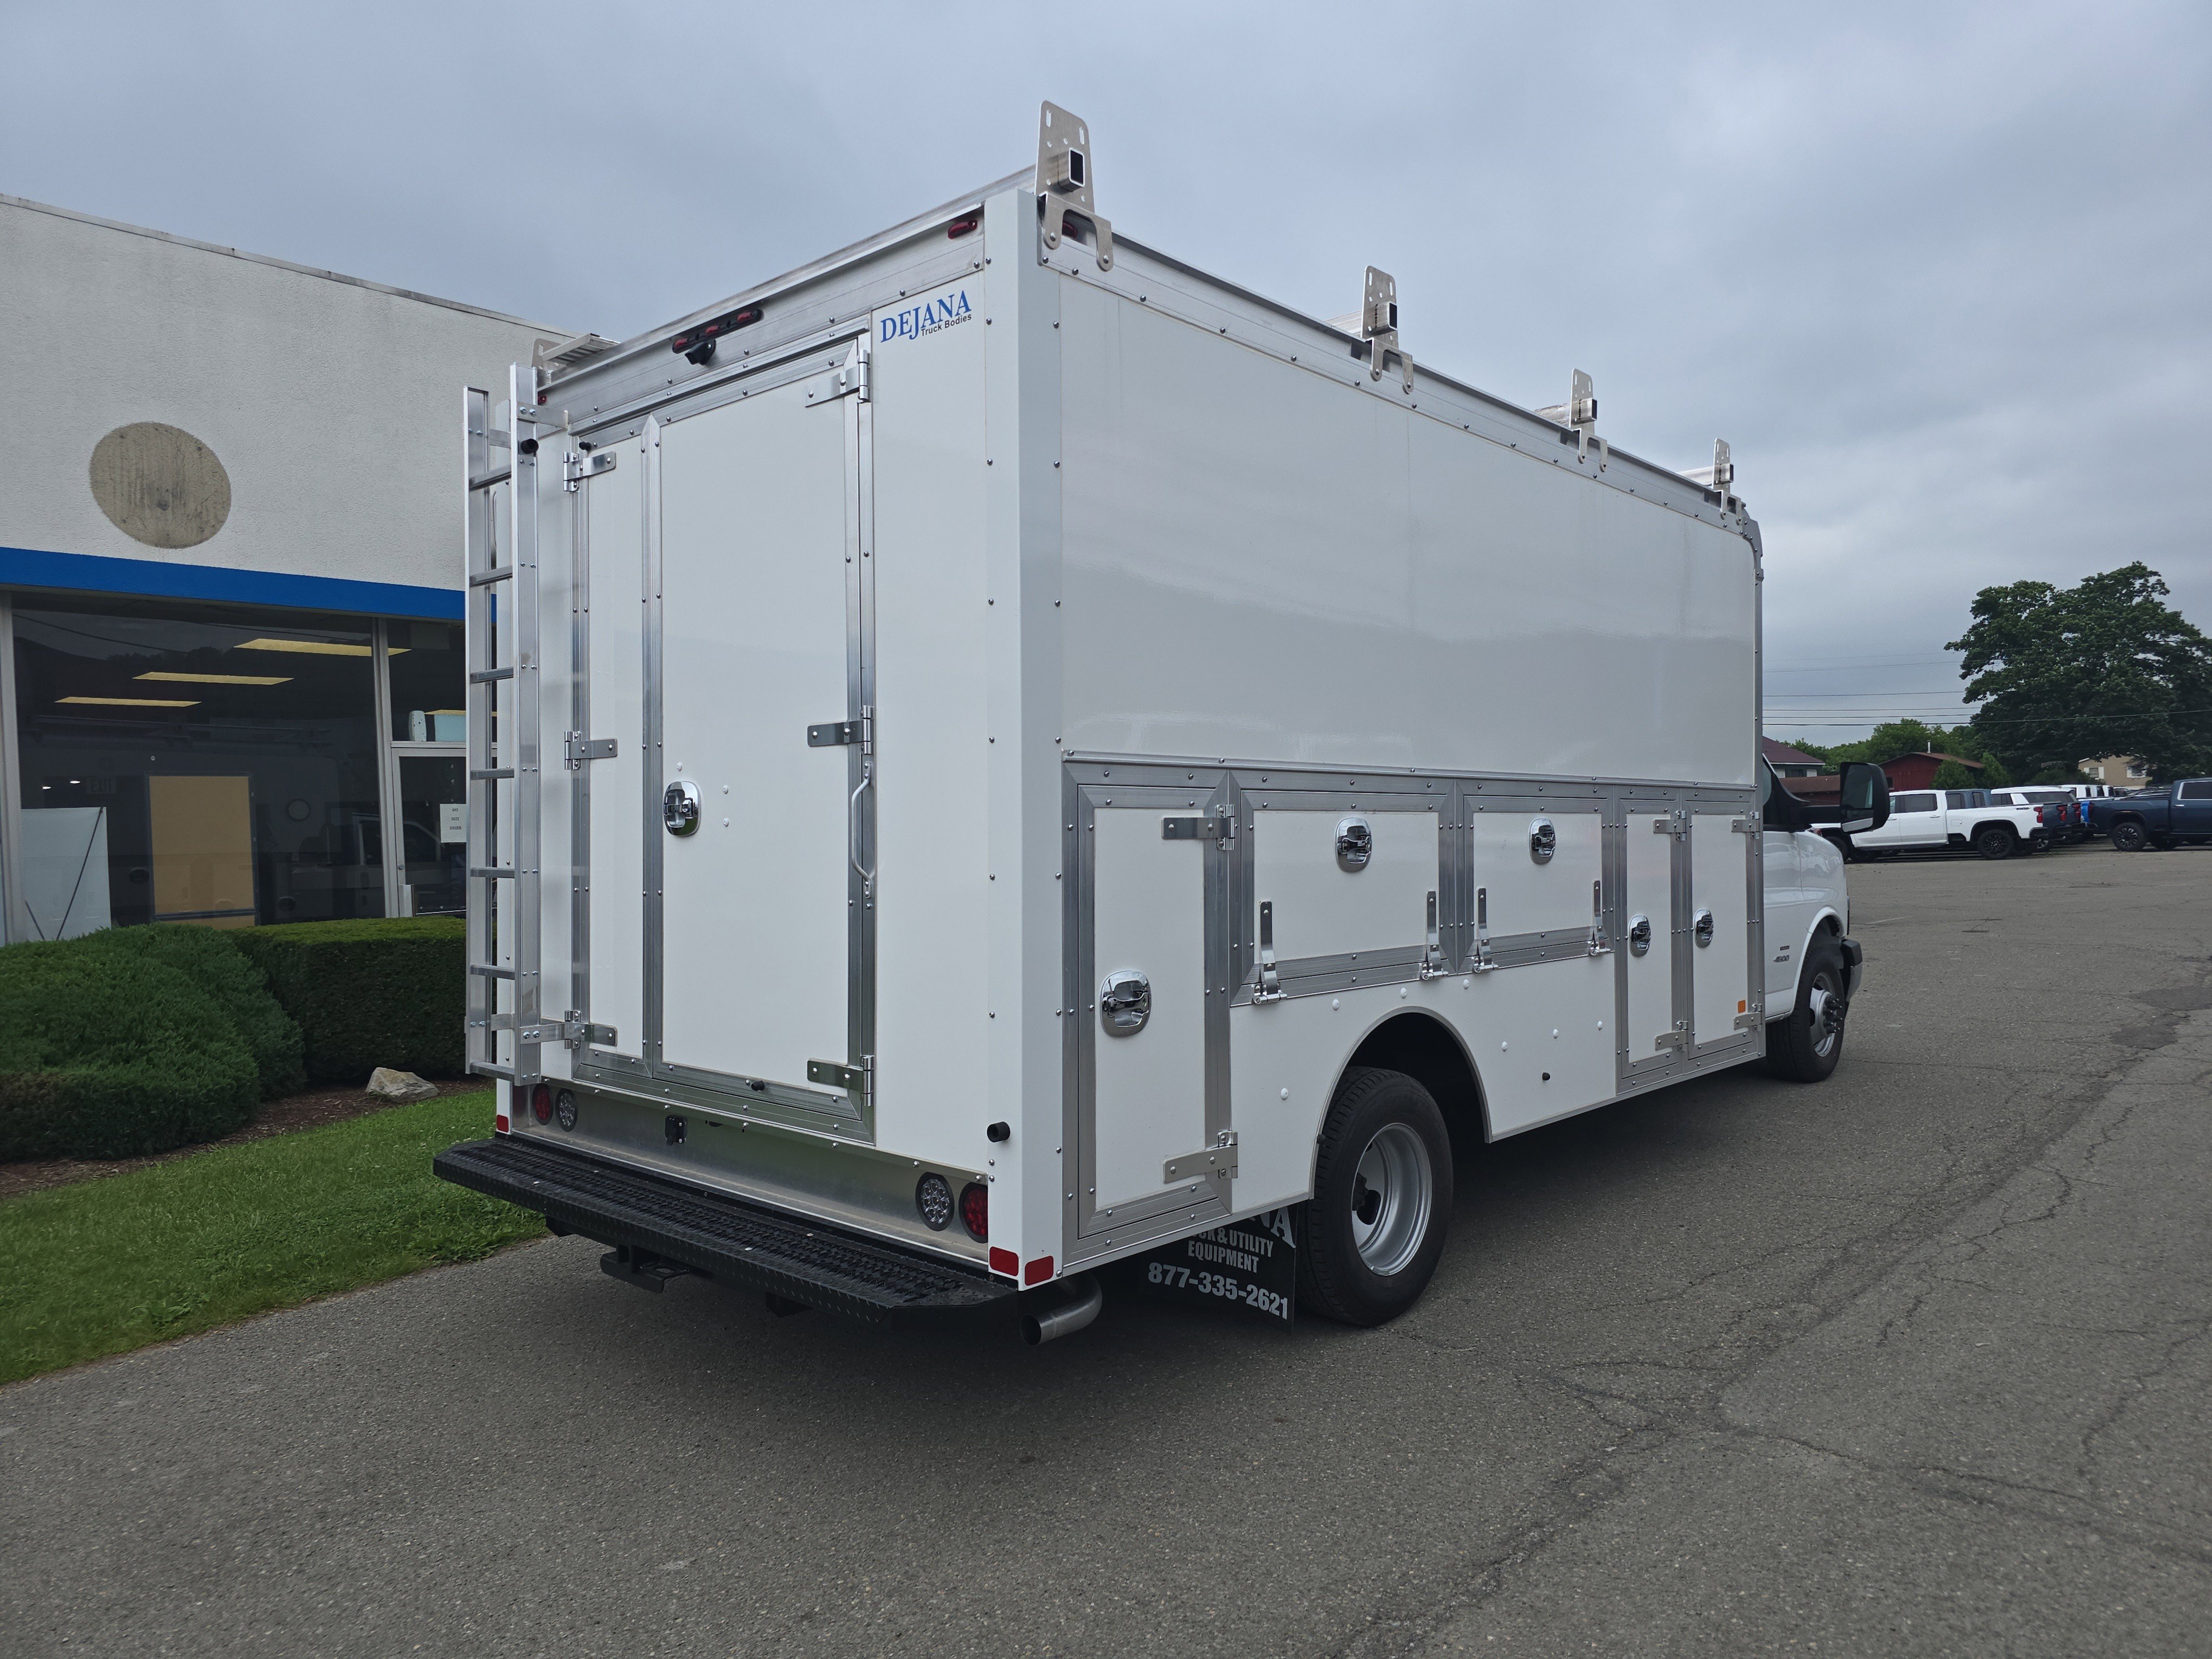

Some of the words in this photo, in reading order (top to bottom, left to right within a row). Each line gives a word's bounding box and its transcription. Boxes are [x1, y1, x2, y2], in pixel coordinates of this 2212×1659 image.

[880, 290, 972, 343] DEJANA
[921, 323, 942, 337] Truck
[945, 313, 972, 329] Bodies
[1188, 1240, 1259, 1274] EQUIPMENT
[1229, 1229, 1274, 1258] UTILITY
[1147, 1262, 1289, 1321] 877-335-2621
